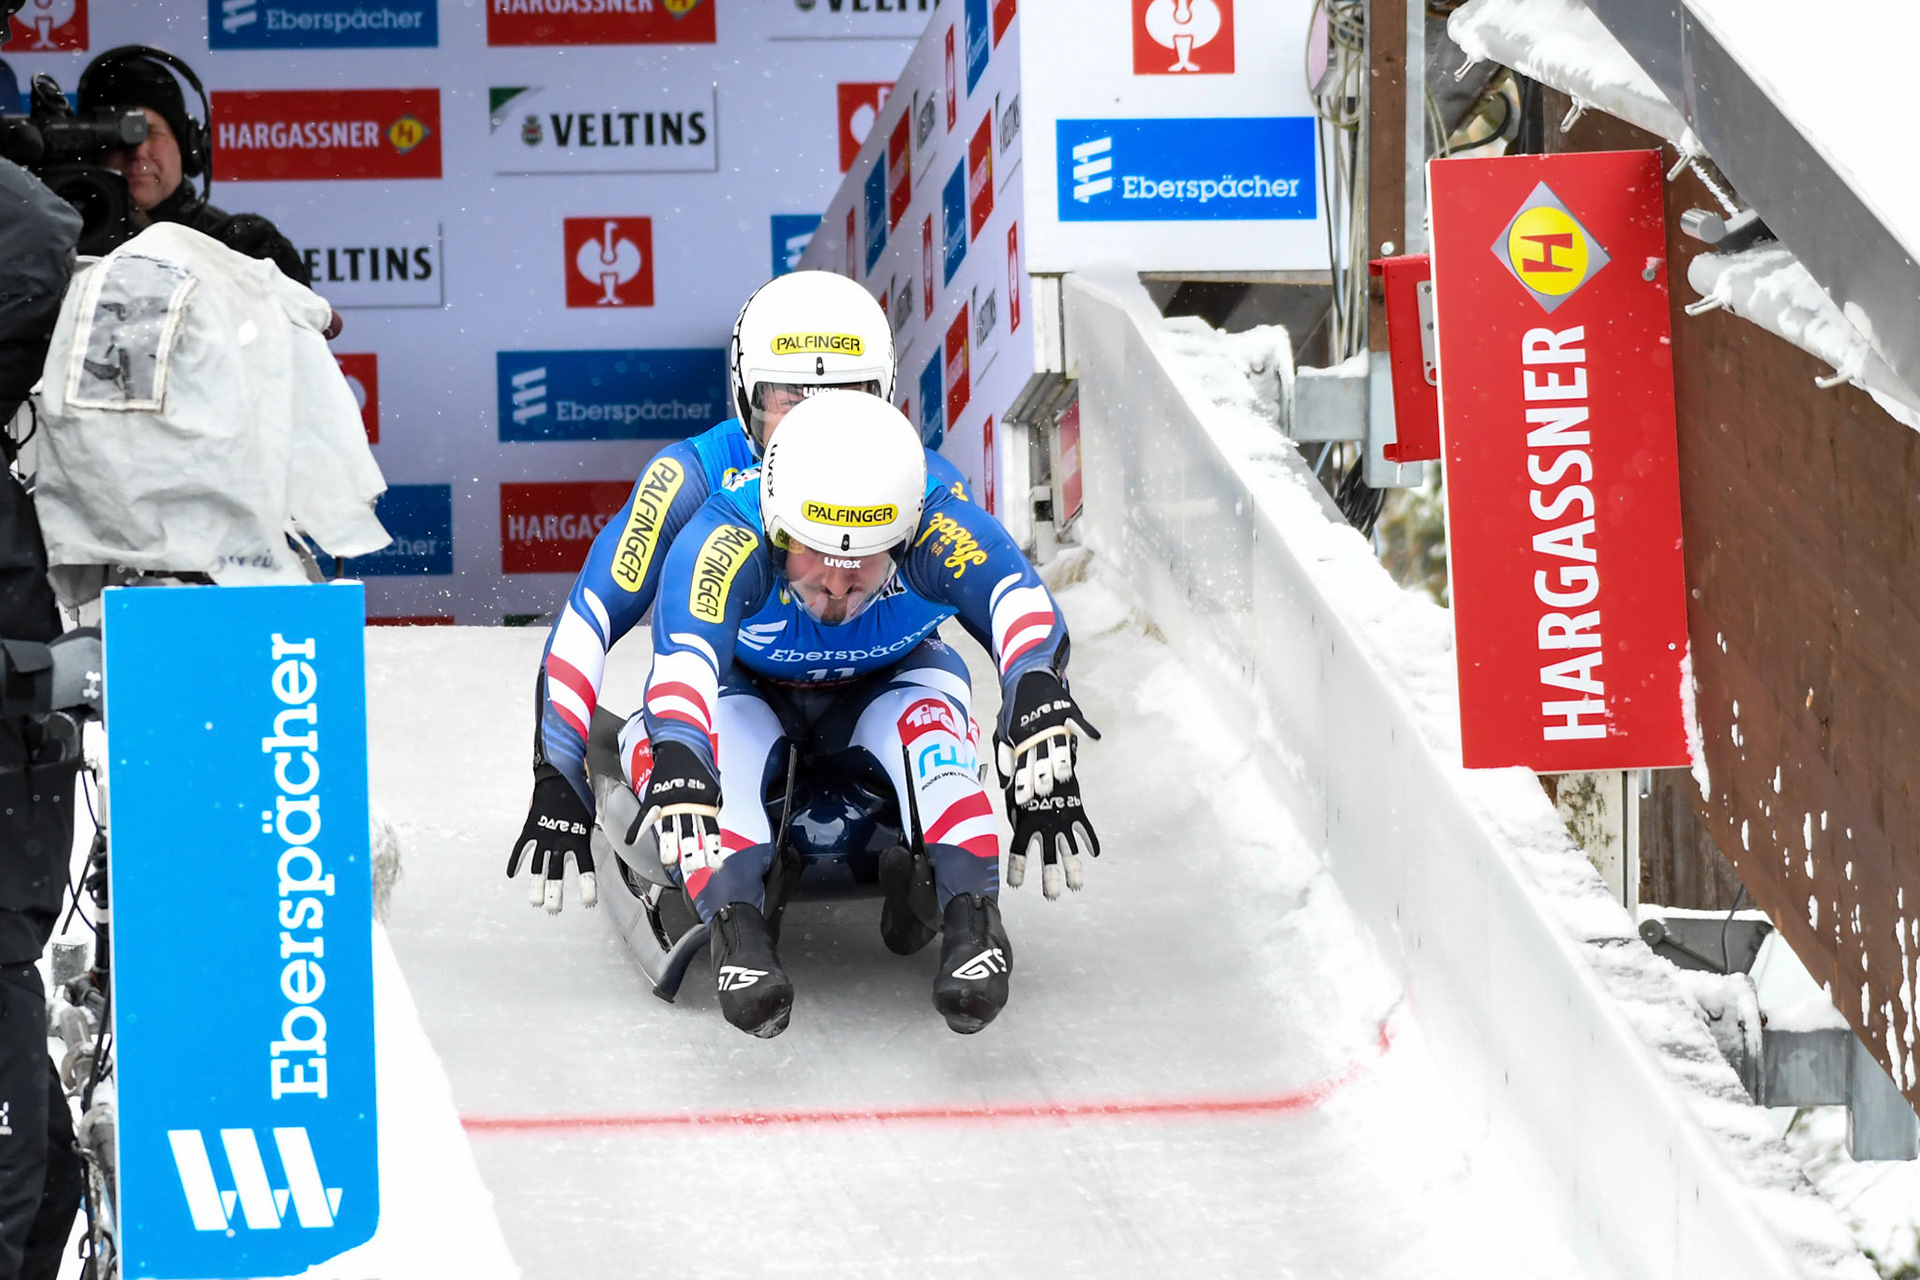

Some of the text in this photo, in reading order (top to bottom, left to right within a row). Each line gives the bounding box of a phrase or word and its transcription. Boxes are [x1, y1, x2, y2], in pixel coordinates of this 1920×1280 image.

[266, 10, 423, 33] Eberspächer
[219, 122, 379, 149] HARGASSNER
[551, 112, 707, 147] VELTINS
[1122, 175, 1299, 203] Eberspächer
[303, 246, 432, 281] ELTINS
[777, 335, 860, 352] PALFINGER
[557, 399, 711, 425] Eberspächer
[767, 444, 778, 499] uvex
[508, 514, 613, 541] HARGAS
[617, 462, 679, 584] PALFINGER
[807, 504, 895, 524] PALFINGER
[1522, 326, 1607, 742] HARGASSNER
[697, 525, 753, 618] PALFINGER
[823, 557, 862, 569] uvex
[767, 613, 948, 663] Eberspächer
[906, 704, 956, 734] Tiro
[262, 633, 335, 1100] Eberspächer
